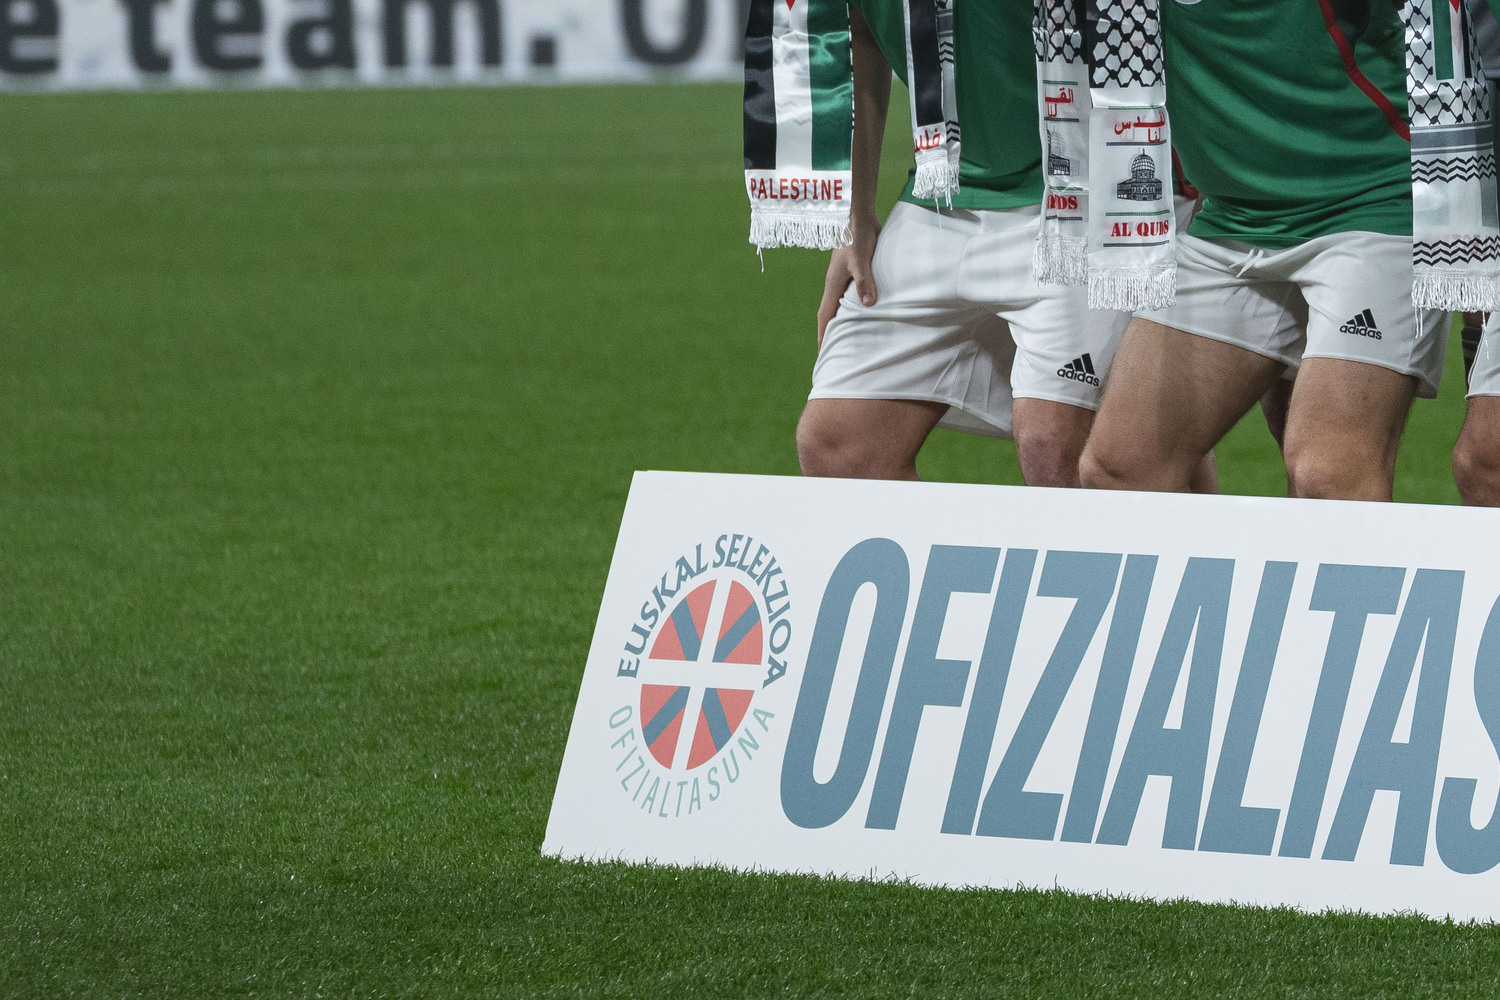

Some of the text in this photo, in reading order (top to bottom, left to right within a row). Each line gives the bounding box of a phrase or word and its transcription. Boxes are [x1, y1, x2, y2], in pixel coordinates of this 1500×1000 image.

[750, 178, 843, 200] PALESTINE
[1110, 219, 1170, 237] AL QUDS
[1338, 323, 1383, 340] adidas
[1056, 365, 1100, 387] adidas
[617, 533, 793, 690] EUSKAL SELEKZIOA
[608, 704, 776, 819] OFIZIALTASUNA
